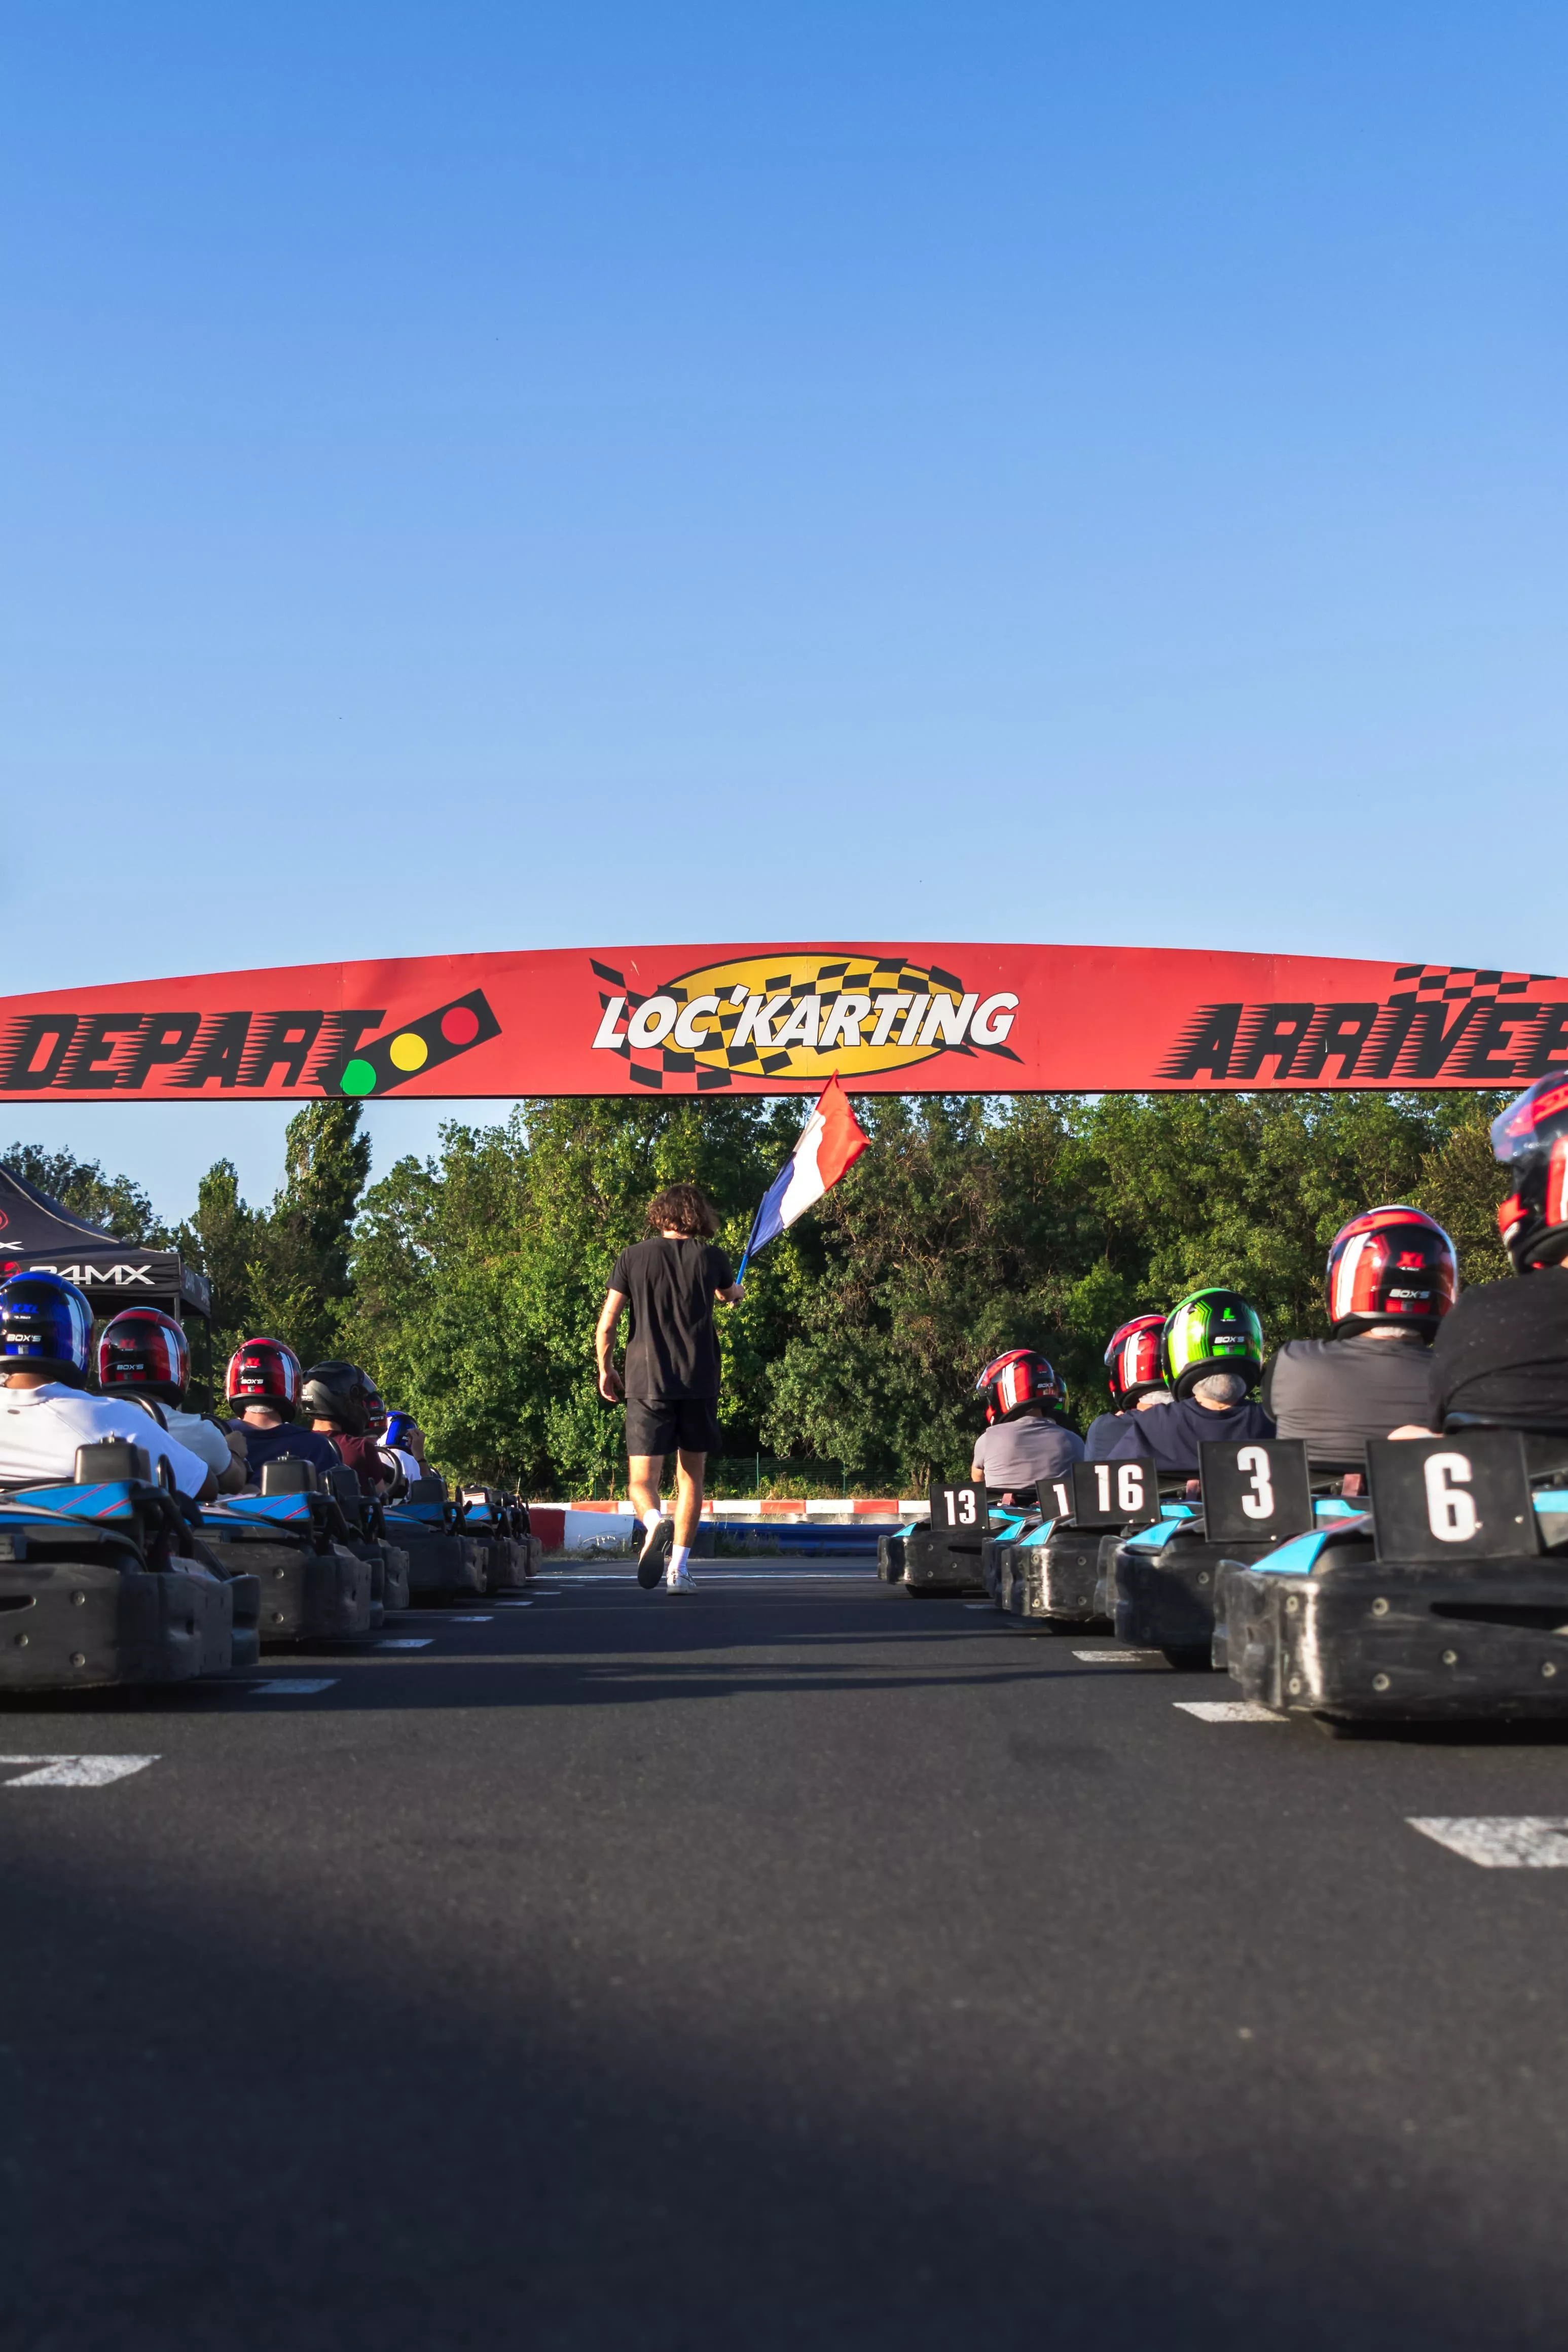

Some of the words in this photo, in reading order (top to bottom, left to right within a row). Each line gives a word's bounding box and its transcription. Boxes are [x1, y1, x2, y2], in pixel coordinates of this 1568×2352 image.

[592, 984, 1020, 1049] LOC'KARTING
[0, 1009, 387, 1095] DEPART
[7, 1333, 42, 1342] BOX'S
[1223, 1307, 1235, 1319] L
[943, 1489, 976, 1526] 13
[1093, 1464, 1144, 1512] 16
[1237, 1445, 1274, 1519] 3
[1424, 1452, 1477, 1542] 6
